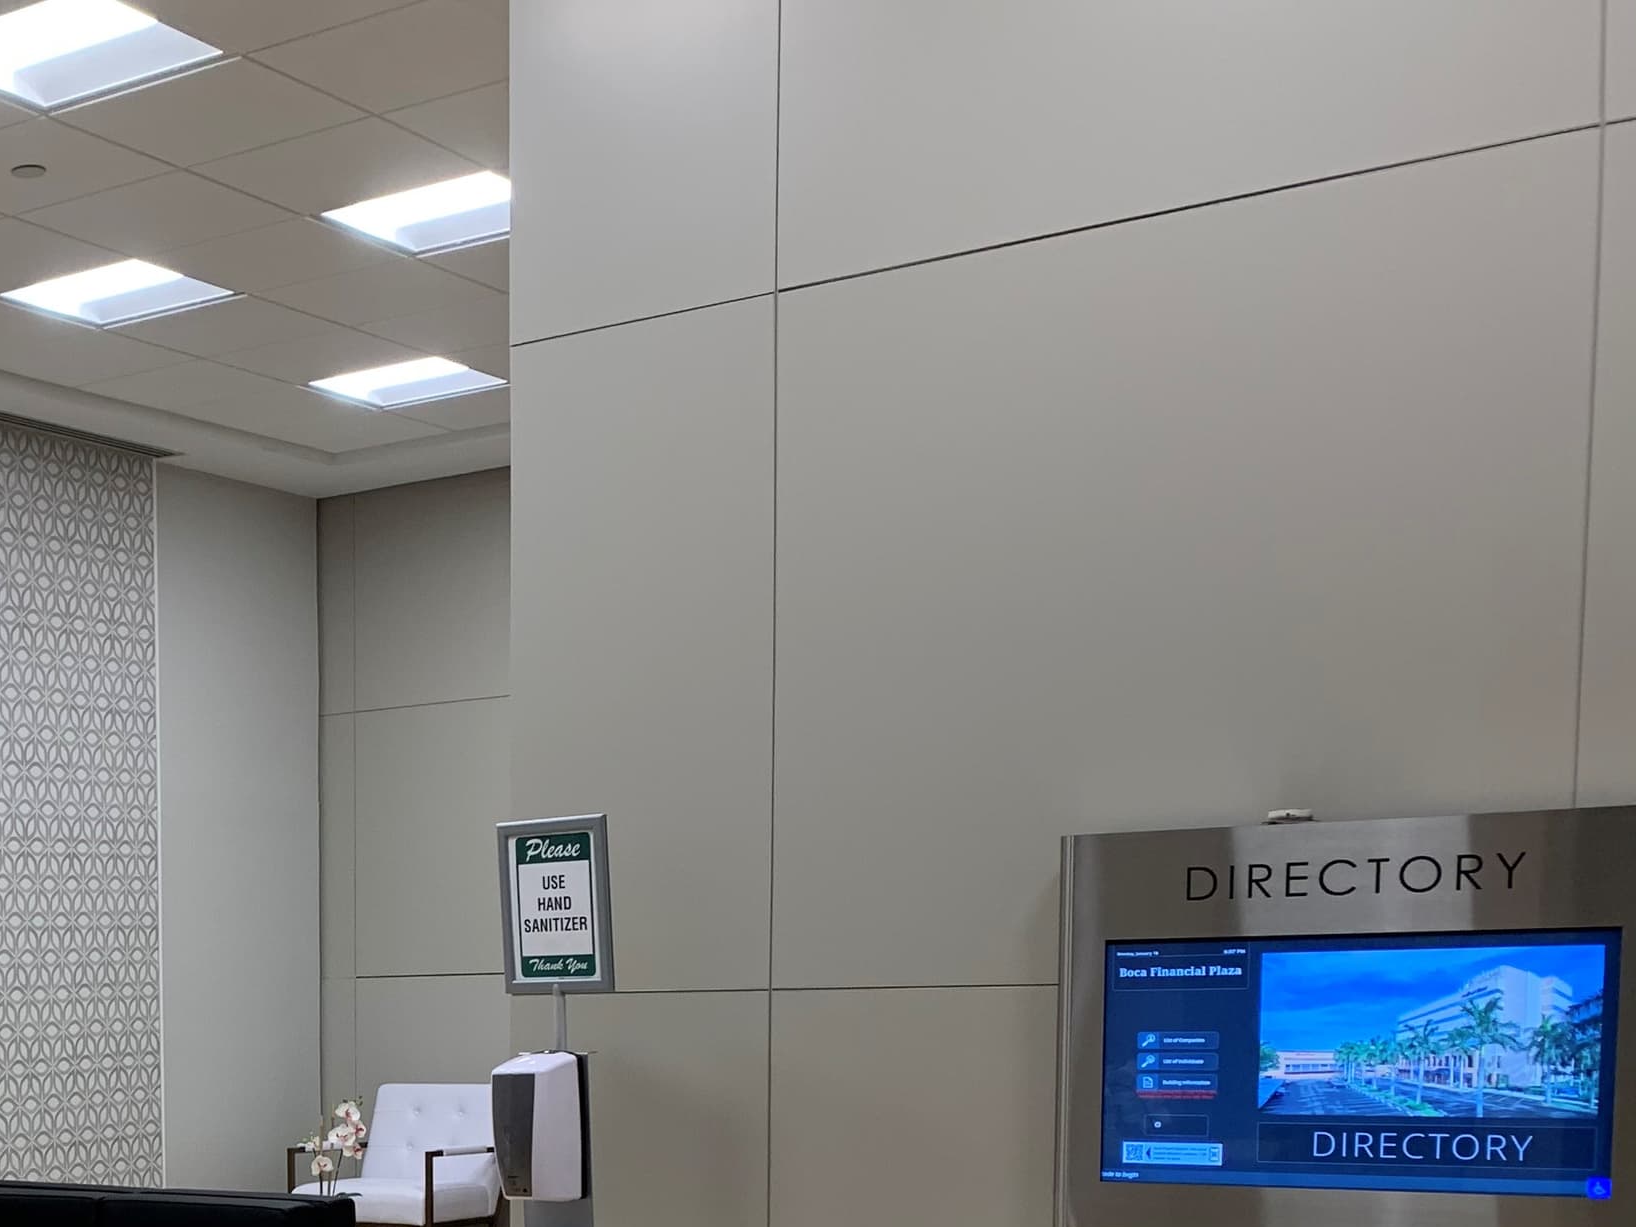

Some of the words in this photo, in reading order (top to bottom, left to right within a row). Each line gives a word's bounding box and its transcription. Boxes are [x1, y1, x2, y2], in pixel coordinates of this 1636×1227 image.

[525, 838, 581, 862] Please
[542, 874, 566, 890] USE
[1185, 851, 1527, 901] DIRECTORY
[537, 895, 572, 912] HAND
[524, 916, 588, 933] SANITIZER
[528, 957, 564, 972] Thank
[565, 957, 589, 974] You
[1119, 967, 1147, 978] Boca
[1150, 966, 1206, 977] Financial
[1209, 965, 1242, 976] Plaza
[1312, 1131, 1534, 1162] DIRECTORY
